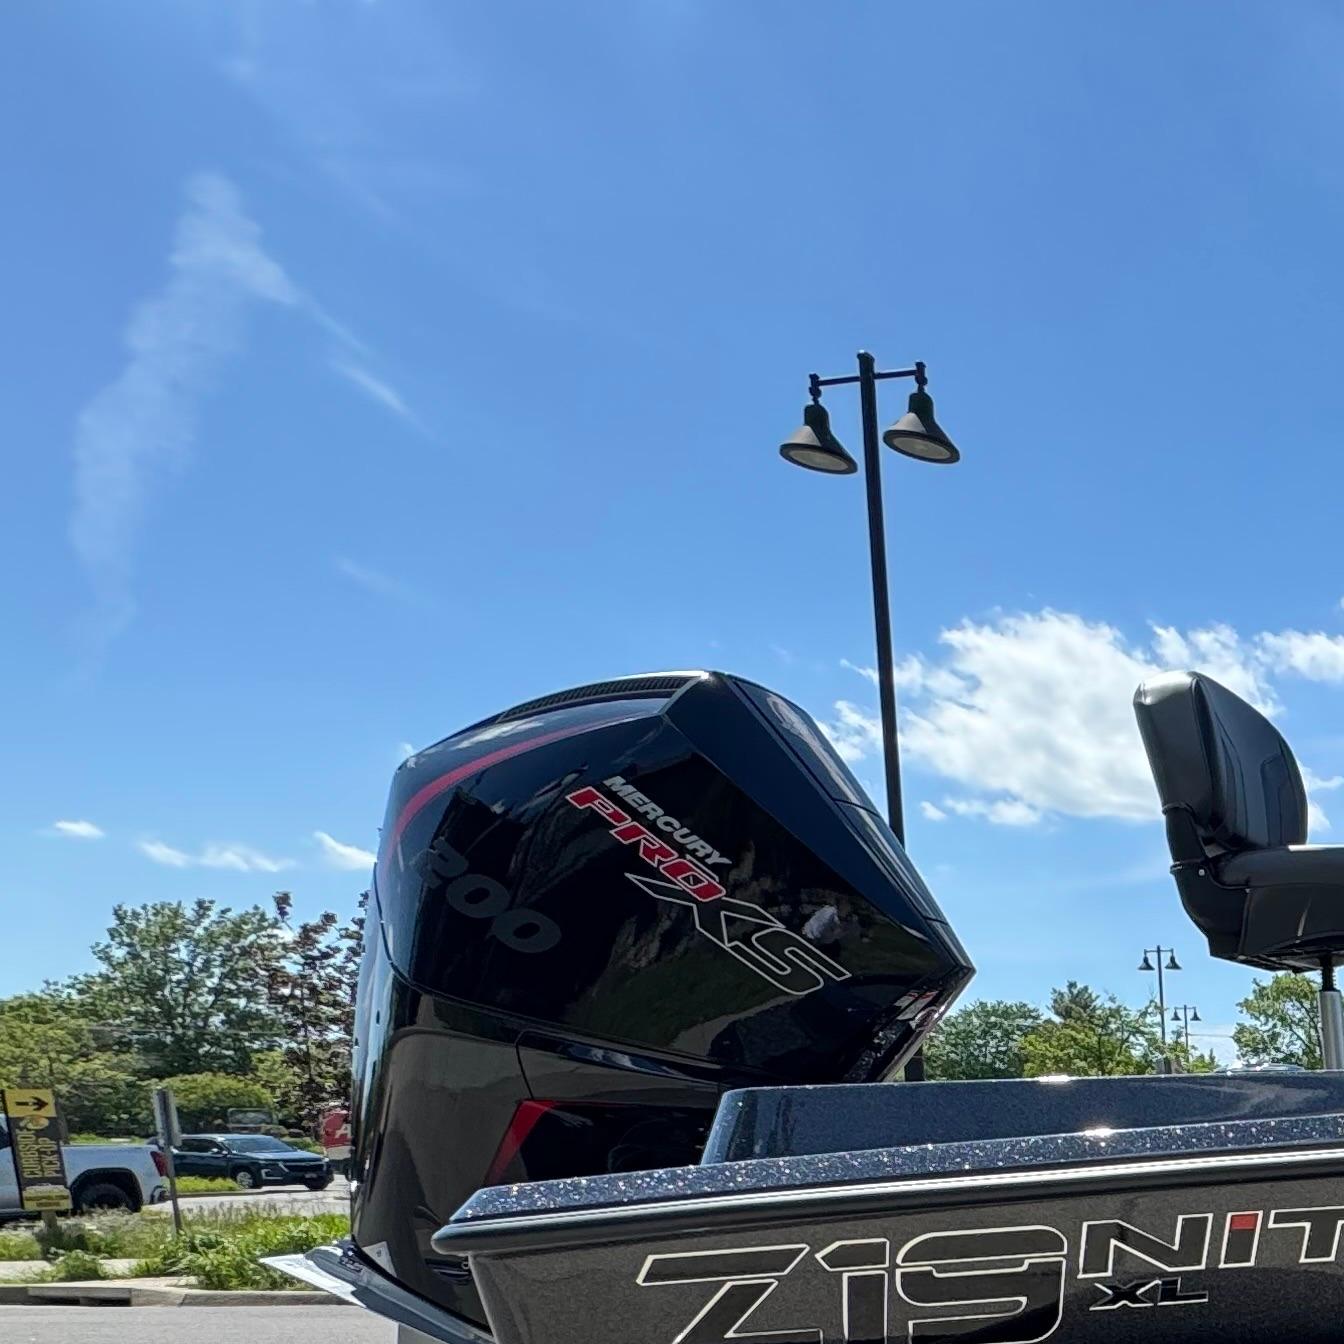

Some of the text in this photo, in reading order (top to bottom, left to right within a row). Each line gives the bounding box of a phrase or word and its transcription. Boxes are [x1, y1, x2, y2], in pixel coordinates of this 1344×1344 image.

[565, 786, 727, 902] PRO
[601, 775, 733, 865] MERCURY
[409, 836, 562, 954] 200
[624, 853, 852, 995] XS
[17, 1128, 43, 1178] CURBSIDE
[38, 1137, 63, 1178] PICK-UP
[1089, 1275, 1209, 1311] XL
